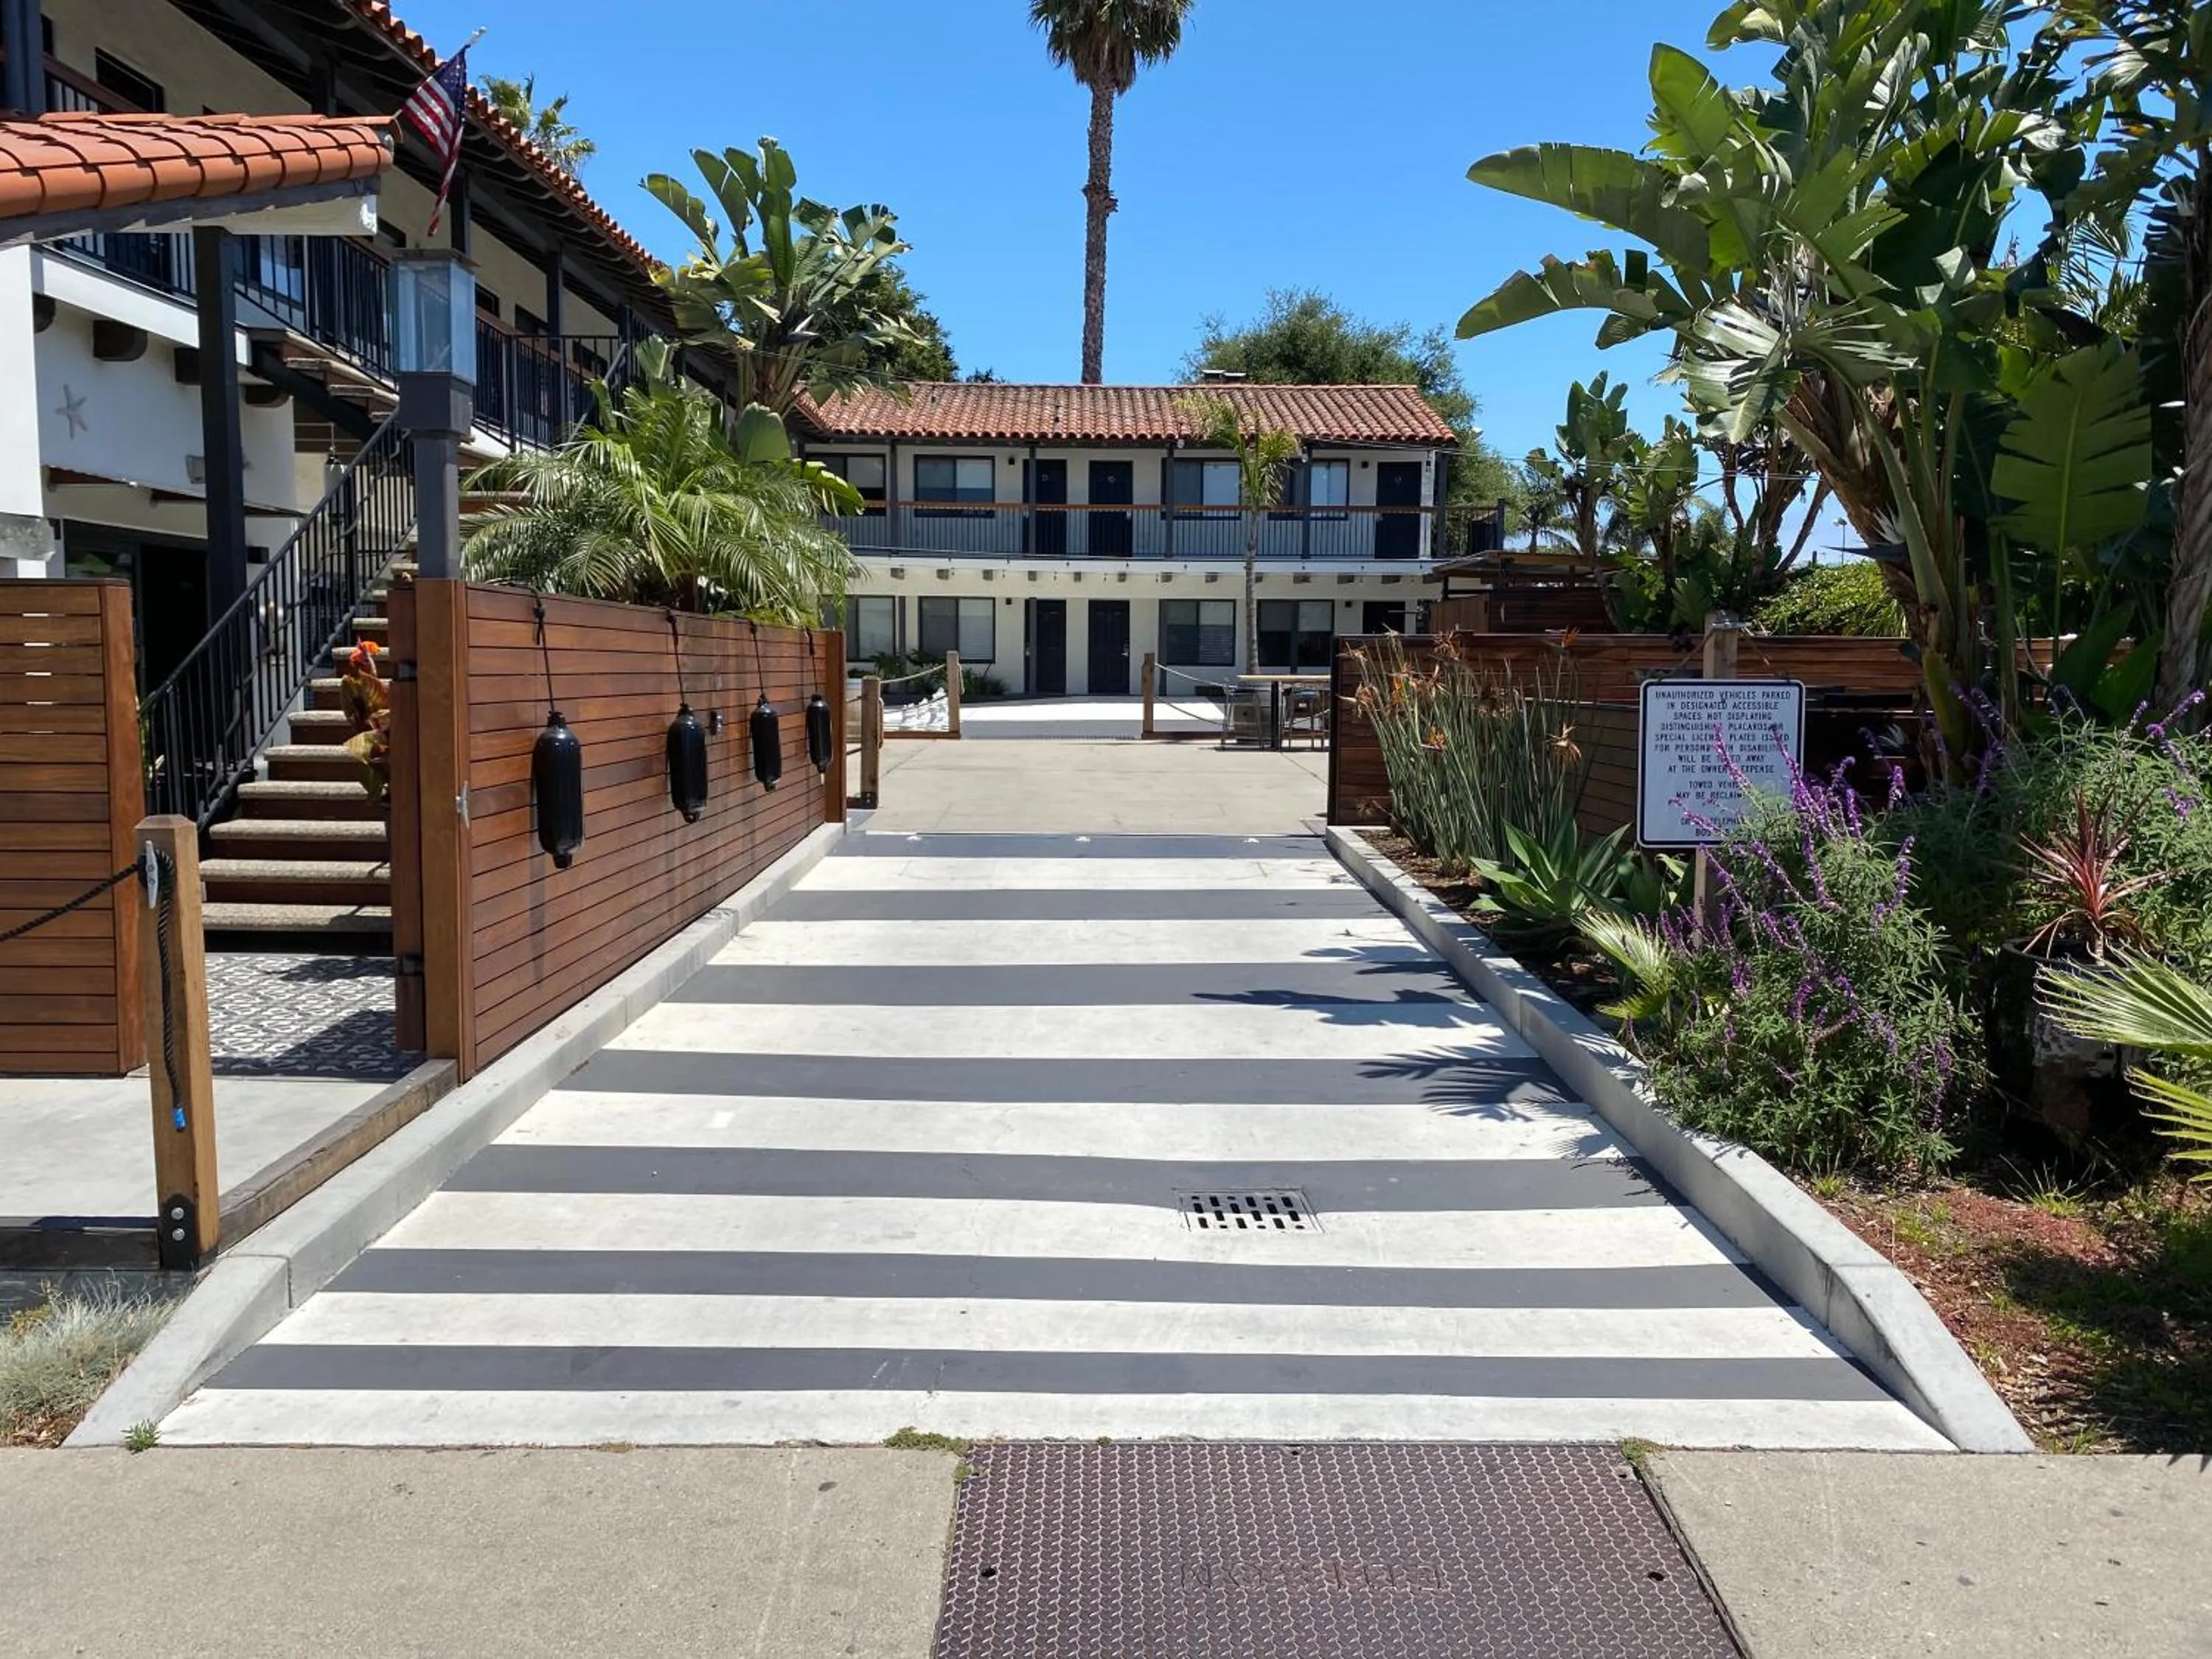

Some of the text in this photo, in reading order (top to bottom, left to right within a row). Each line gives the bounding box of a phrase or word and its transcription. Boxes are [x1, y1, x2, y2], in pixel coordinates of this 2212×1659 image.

[1655, 691, 1791, 700] UNAUTHORIZED VEHICLES PARKED
[1666, 701, 1779, 710] IN DESIGNATED ACCESSIBLE
[1673, 712, 1772, 720] SPACES NOT DISPLAYING
[1660, 722, 1722, 731] DISTINGUISHI
[1728, 722, 1767, 731] PLACARDS
[1655, 733, 1790, 742] SPECIAL LICEN PLATES ISSD
[1655, 744, 1670, 753] FOR
[1677, 754, 1765, 763] WILL BE TED AWAY
[1668, 765, 1677, 773] AT
[1681, 765, 1696, 773] THE
[1741, 765, 1775, 773] EXPENSE
[1689, 780, 1713, 789] TOWED
[1676, 791, 1747, 800] MAY BE RECLAIME
